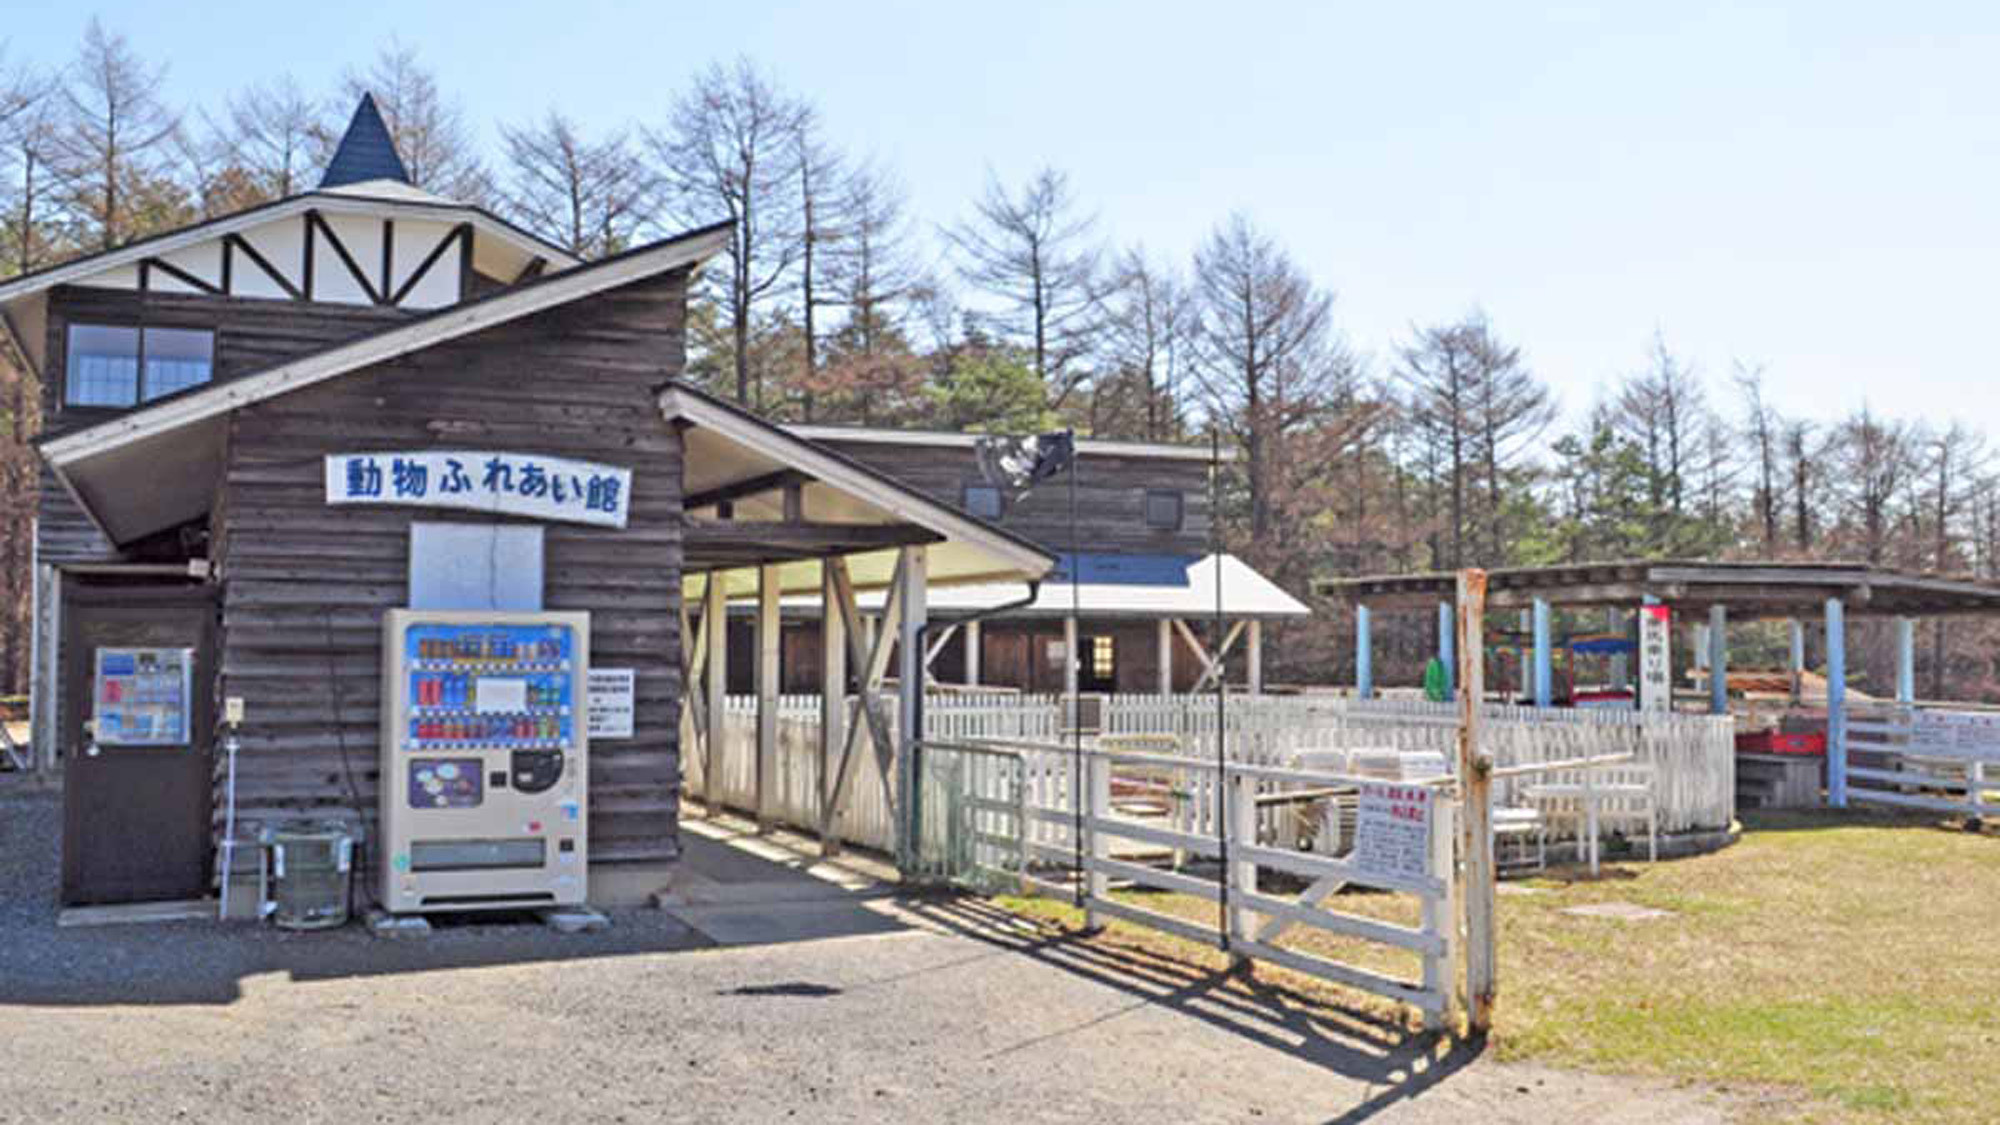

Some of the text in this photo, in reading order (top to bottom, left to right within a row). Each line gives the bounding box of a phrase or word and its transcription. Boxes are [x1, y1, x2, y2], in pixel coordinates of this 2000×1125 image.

[345, 456, 622, 513] 動物ふれあい館
